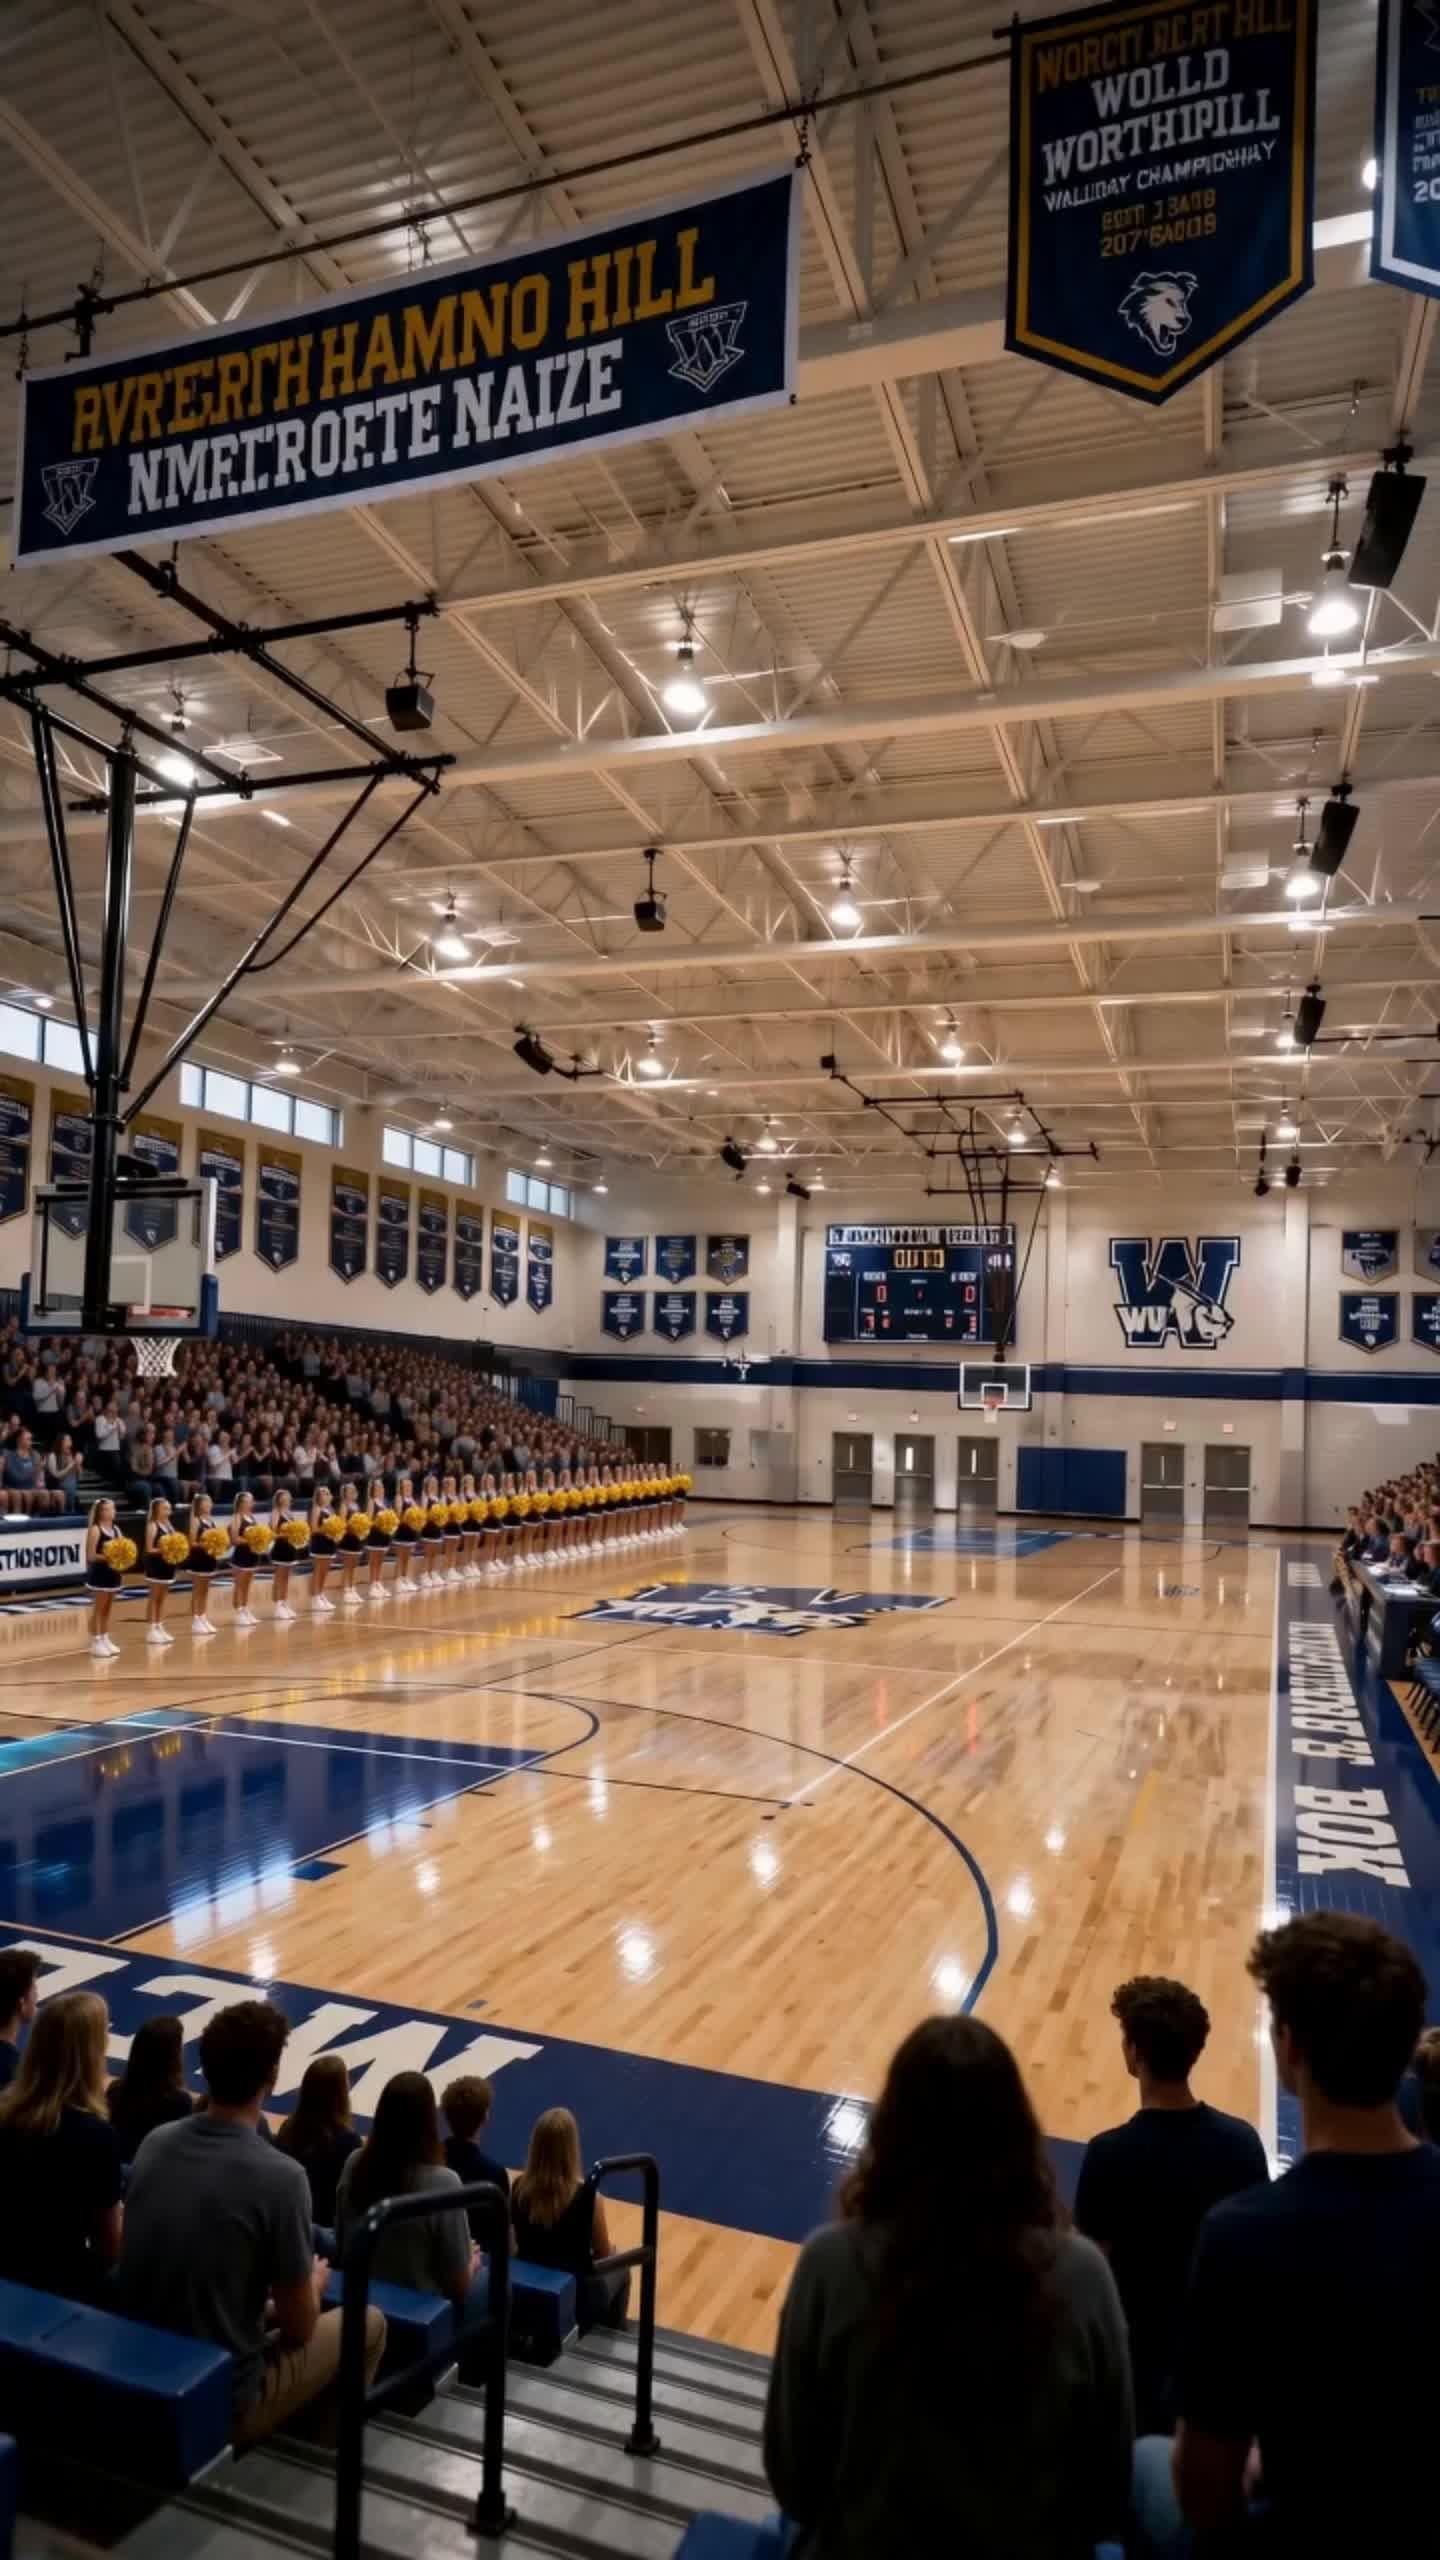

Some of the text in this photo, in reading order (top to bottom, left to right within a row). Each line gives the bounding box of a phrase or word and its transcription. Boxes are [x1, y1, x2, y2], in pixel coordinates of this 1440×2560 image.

[1091, 48, 1230, 119] WOLLD
[565, 227, 716, 341] HILL
[452, 337, 623, 449] NAIZE
